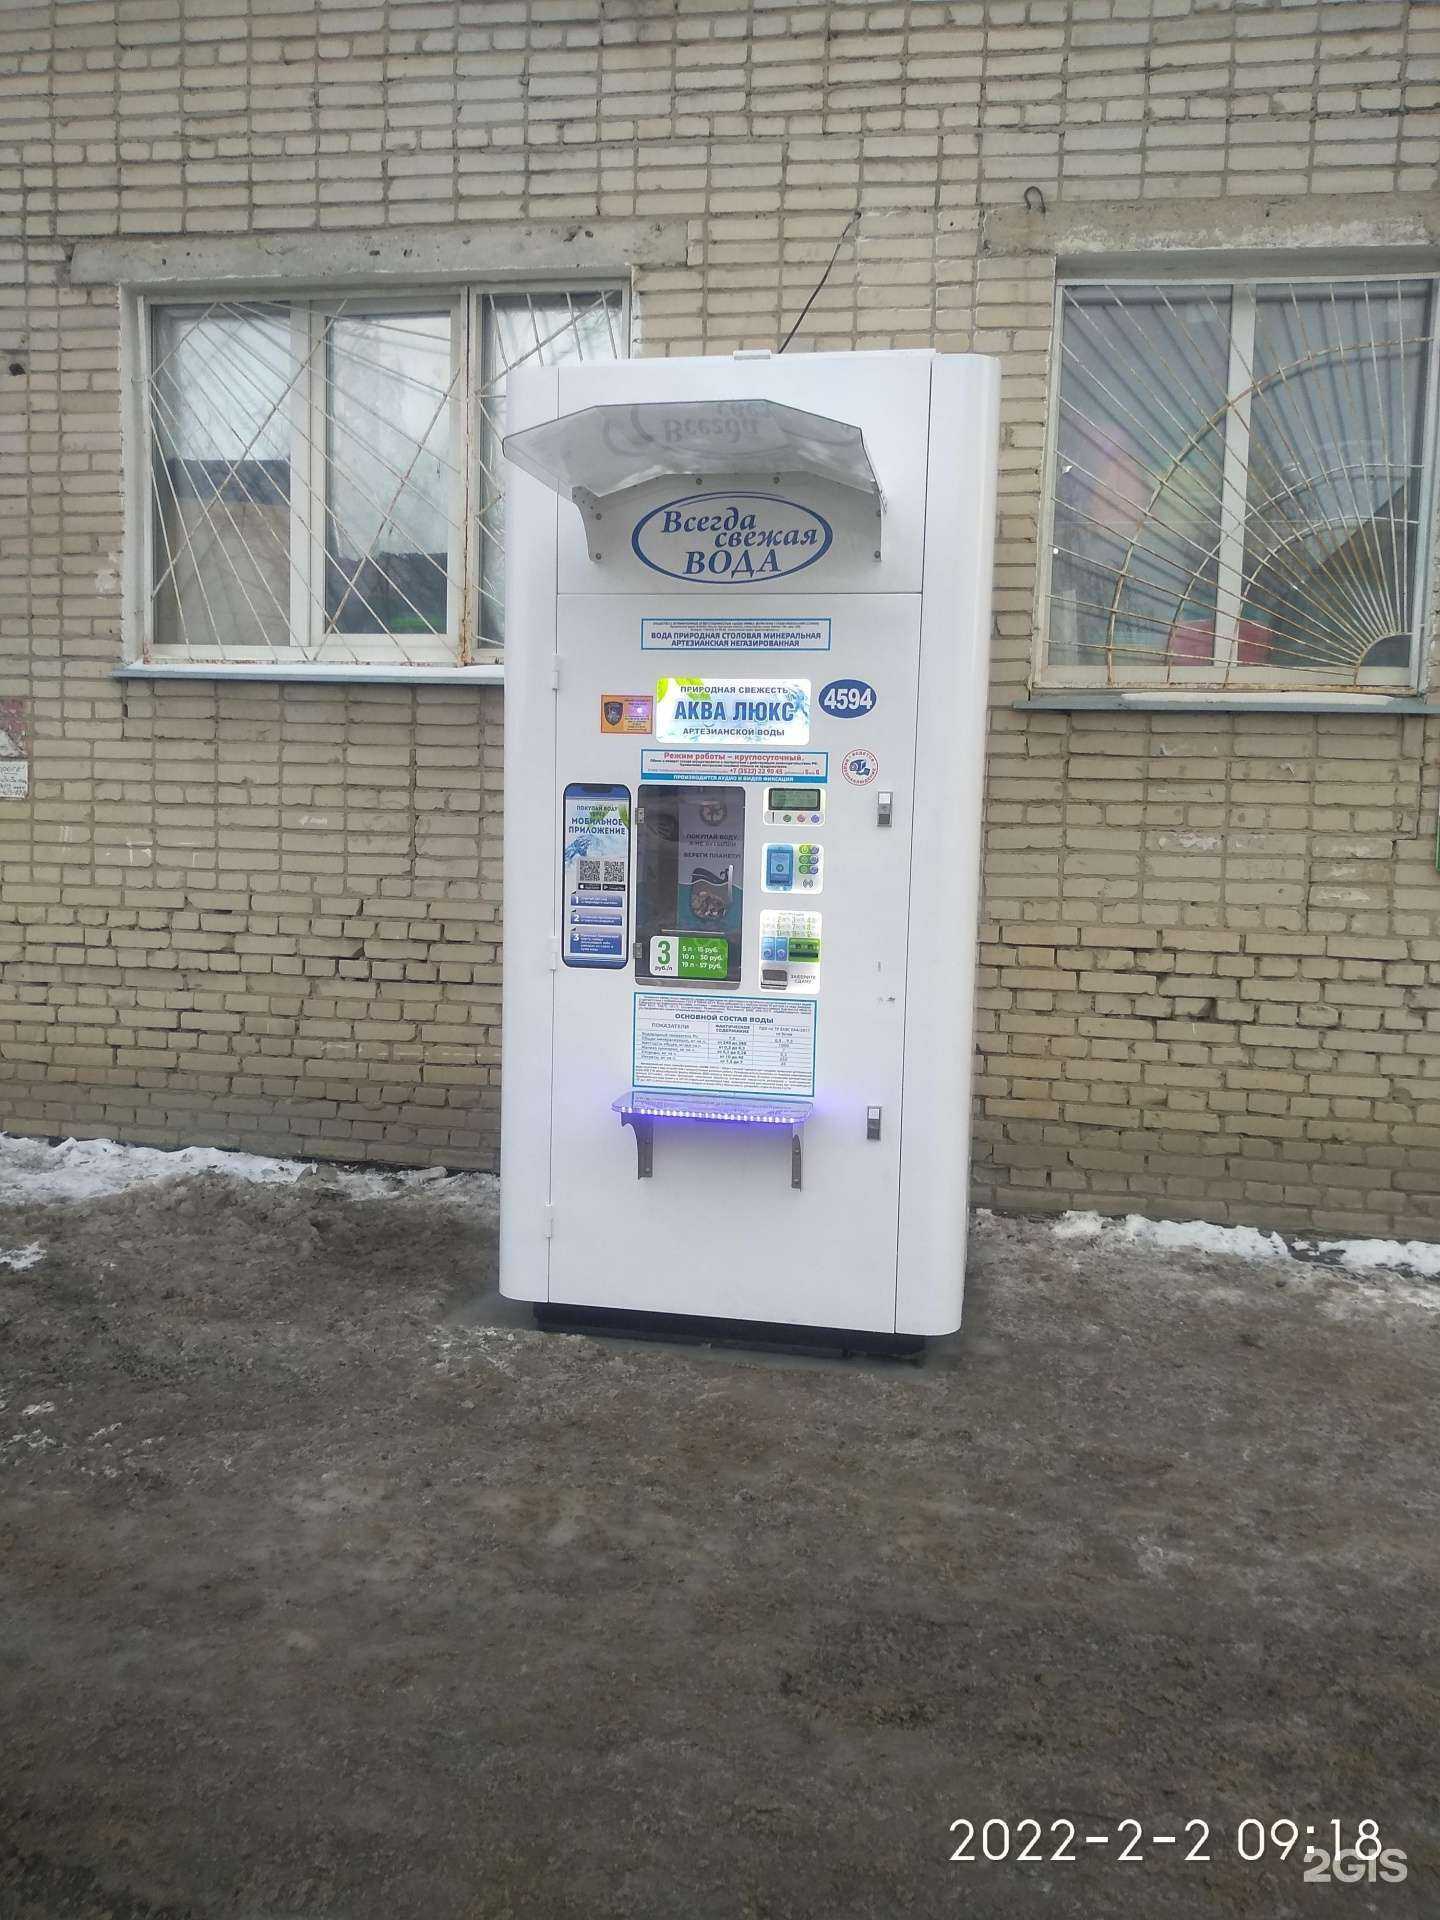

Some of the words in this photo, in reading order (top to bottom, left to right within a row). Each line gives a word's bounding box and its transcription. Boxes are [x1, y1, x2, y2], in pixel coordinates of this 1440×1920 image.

[661, 507, 757, 534] Всегда
[714, 527, 818, 549] свежая
[682, 549, 782, 579] ВОДА
[651, 632, 673, 640] ВОДА
[673, 632, 721, 640] ПРИРОДНАЯ
[721, 632, 762, 640] СТОЛОВАЯ
[763, 632, 822, 640] МИНЕРАЛЬНАЯ
[671, 639, 729, 647] АРТЕЗИАНСКАЯ
[730, 639, 800, 647] НЕГАЗИРОВАННАЯ
[680, 686, 737, 694] ПРИРОДНАЯ
[738, 686, 789, 694] СВЕЖЕСТЬ
[823, 688, 874, 710] 4594
[674, 701, 727, 721] АКВА
[732, 701, 795, 722] ЛЮКС
[683, 727, 756, 736] АРТЕЗИАНСКОЙ
[757, 728, 785, 737] ВОДЫ
[664, 752, 694, 760] Режим
[571, 817, 623, 826] МОБИЛЬНОЕ
[568, 826, 626, 835] ПРИЛОЖЕНИЕ
[574, 914, 580, 922] 2
[573, 933, 580, 942] 3
[657, 940, 671, 965] 3
[674, 1013, 718, 1021] ОСНОВНОЙ
[718, 1015, 749, 1023] СОСТАВ
[749, 1017, 775, 1025] ВОДЫ
[651, 1022, 690, 1030] ПОКАЗАТЕЛИ
